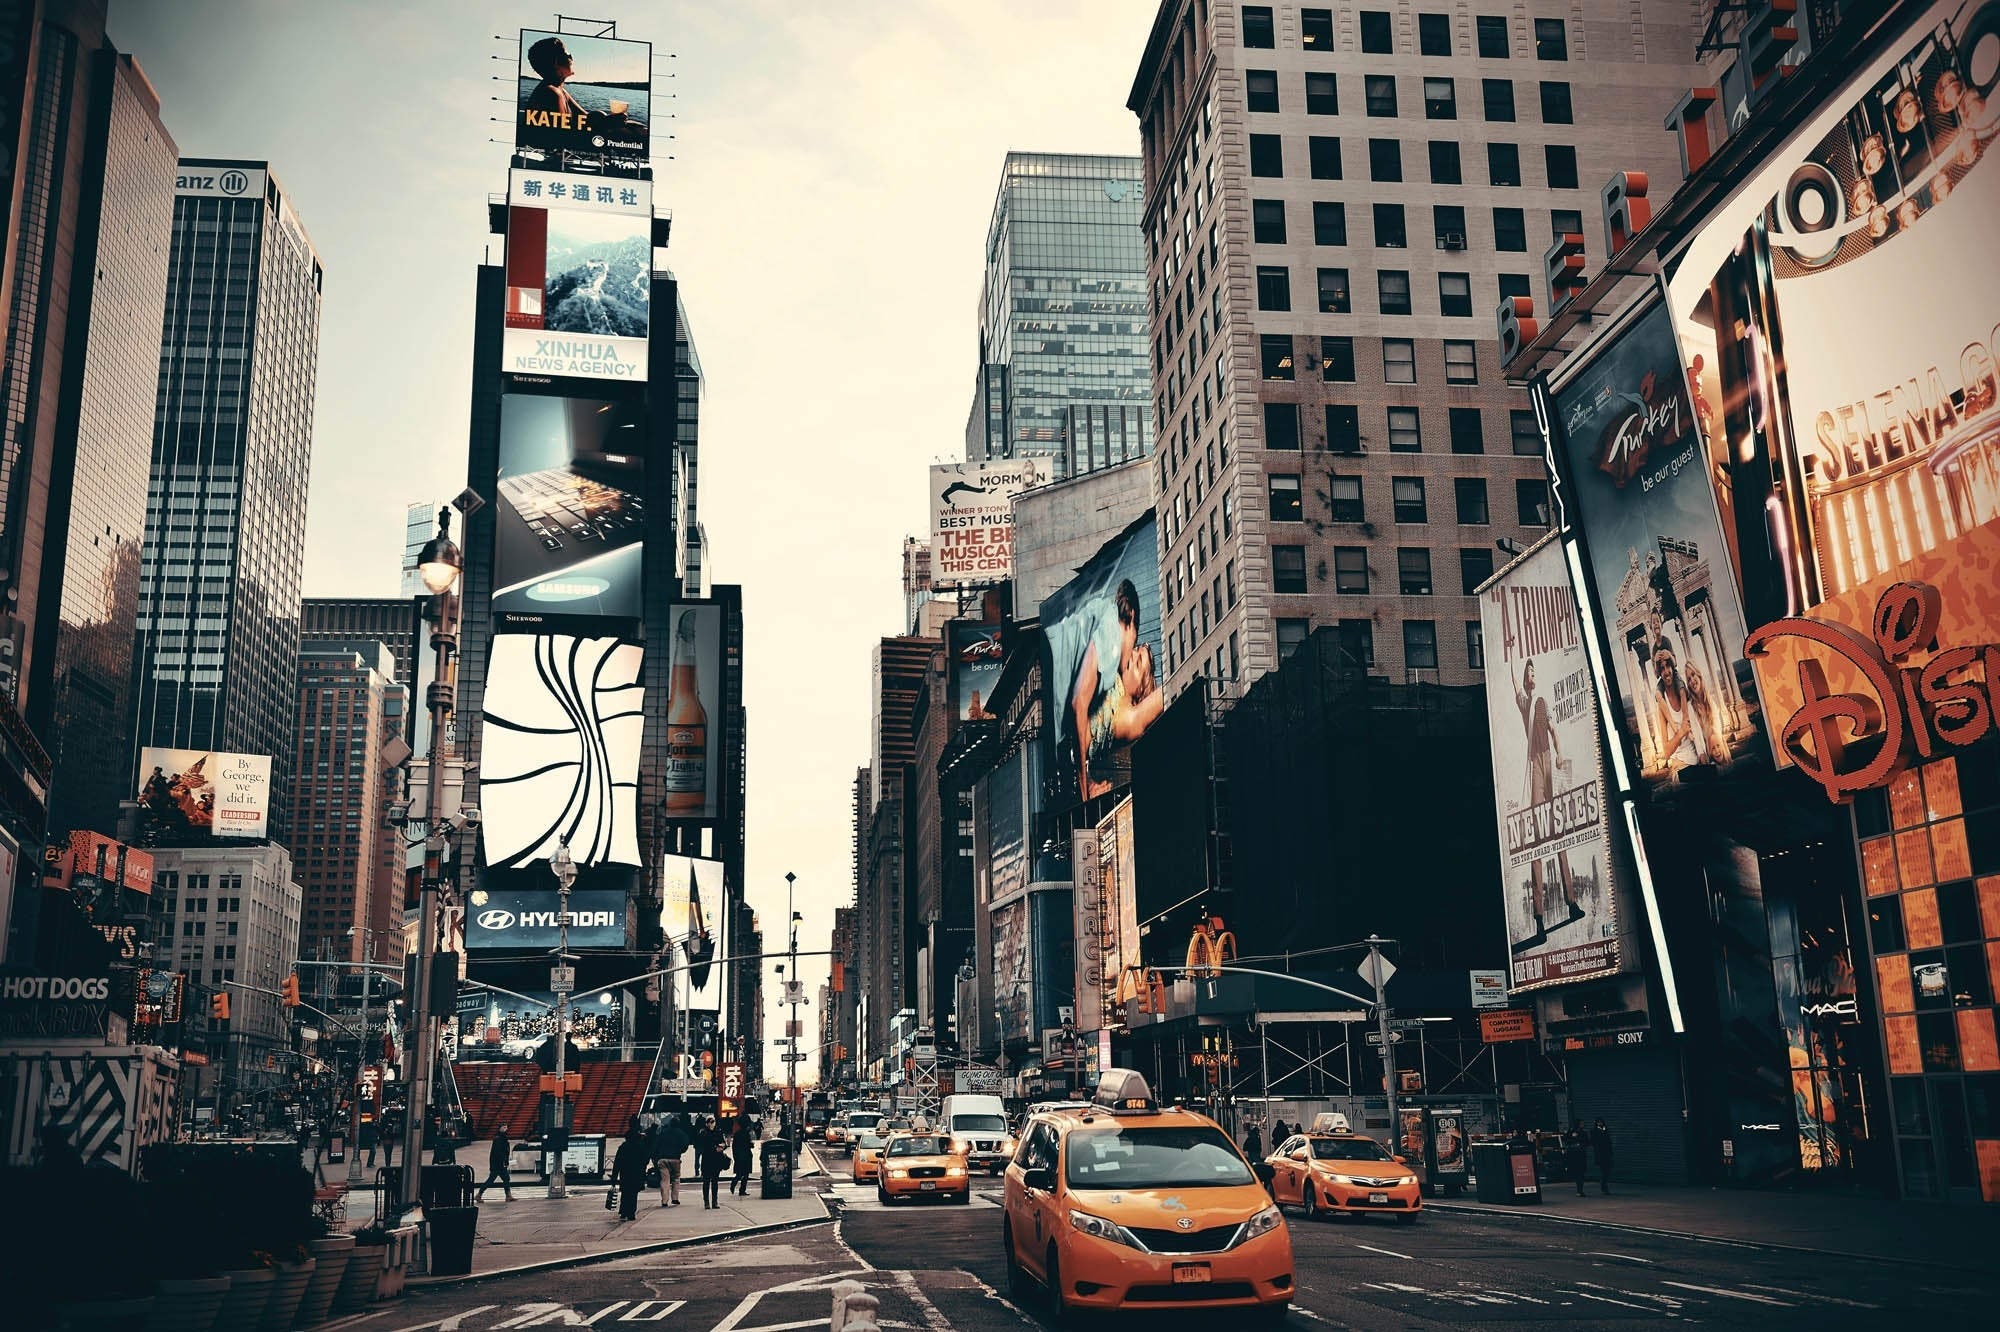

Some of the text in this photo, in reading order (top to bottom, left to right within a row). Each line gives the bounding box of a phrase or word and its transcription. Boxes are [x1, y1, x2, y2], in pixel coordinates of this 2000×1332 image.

[526, 109, 592, 131] KATE F.
[607, 140, 643, 149] Prudential
[176, 175, 214, 190] anz
[523, 180, 638, 206] 新华通讯社
[535, 339, 618, 361] XINHUA
[516, 356, 637, 376] NEWS AGENCY
[1608, 395, 1681, 464] Turkey
[1816, 366, 1960, 482] SELENA
[1640, 444, 1694, 493] be our guest
[940, 507, 975, 516] WINNER
[985, 505, 1009, 513] TONY
[940, 516, 976, 529] BEST
[941, 560, 974, 573] THIS
[1511, 586, 1578, 659] TRIUMPH!
[971, 662, 997, 672] be our
[1553, 668, 1585, 702] NEW YORK'S
[238, 759, 251, 770] By
[222, 769, 265, 783] George,
[235, 784, 249, 792] we
[226, 792, 257, 804] did it.
[222, 810, 258, 820] LEADERSHIP
[1507, 782, 1598, 850] NEWSIES
[1511, 828, 1600, 866] THE TONY AWARD-WINNING MUSICAL
[519, 911, 615, 928] HYUNDAI
[1081, 840, 1100, 986] PALACE
[1552, 953, 1566, 964] BLOCKS
[1566, 951, 1579, 961] SOUTH
[1583, 945, 1603, 958] Broadway
[1514, 957, 1543, 983] SEIZE THE DAY
[4, 977, 109, 999] HOT DOGS
[1489, 1019, 1524, 1027] COMPUTERS
[1617, 1031, 1643, 1044] SONY
[725, 1065, 741, 1098] tkts
[961, 1070, 981, 1079] GOING
[982, 1070, 994, 1078] OUT
